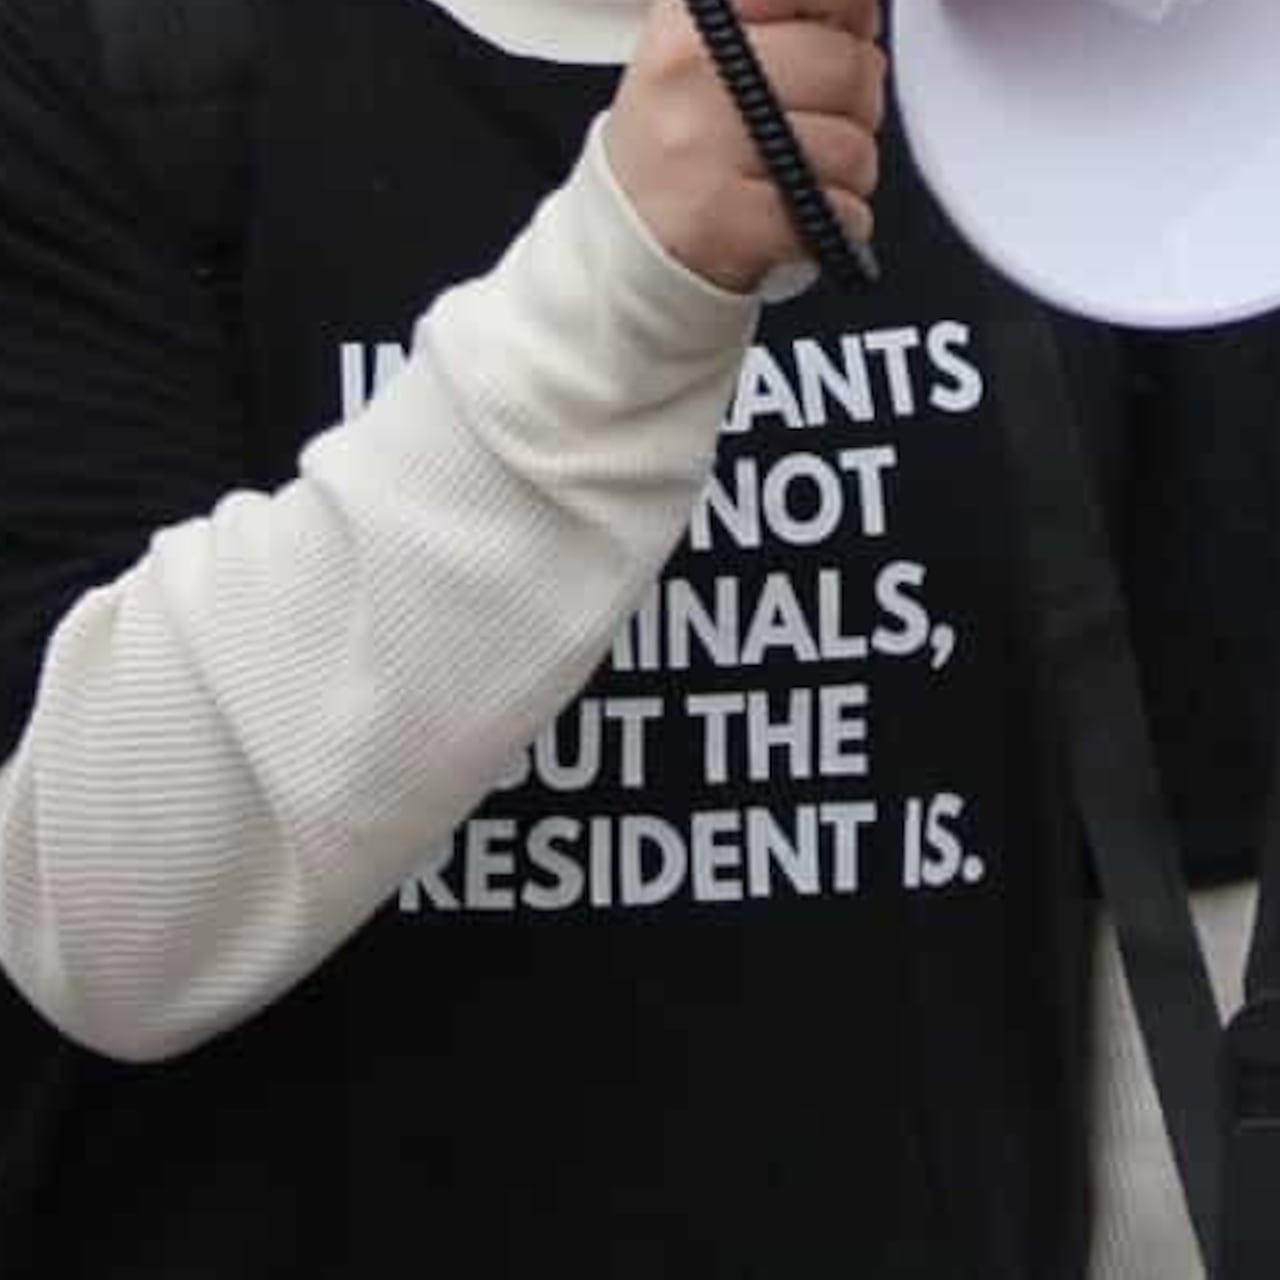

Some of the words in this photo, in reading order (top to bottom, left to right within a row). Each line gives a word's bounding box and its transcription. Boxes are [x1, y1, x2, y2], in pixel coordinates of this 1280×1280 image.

[690, 446, 898, 552] NOT
[610, 560, 956, 670] INALS,
[686, 684, 870, 786] THE
[397, 800, 877, 914] RESIDENT
[903, 792, 984, 890] IS.
